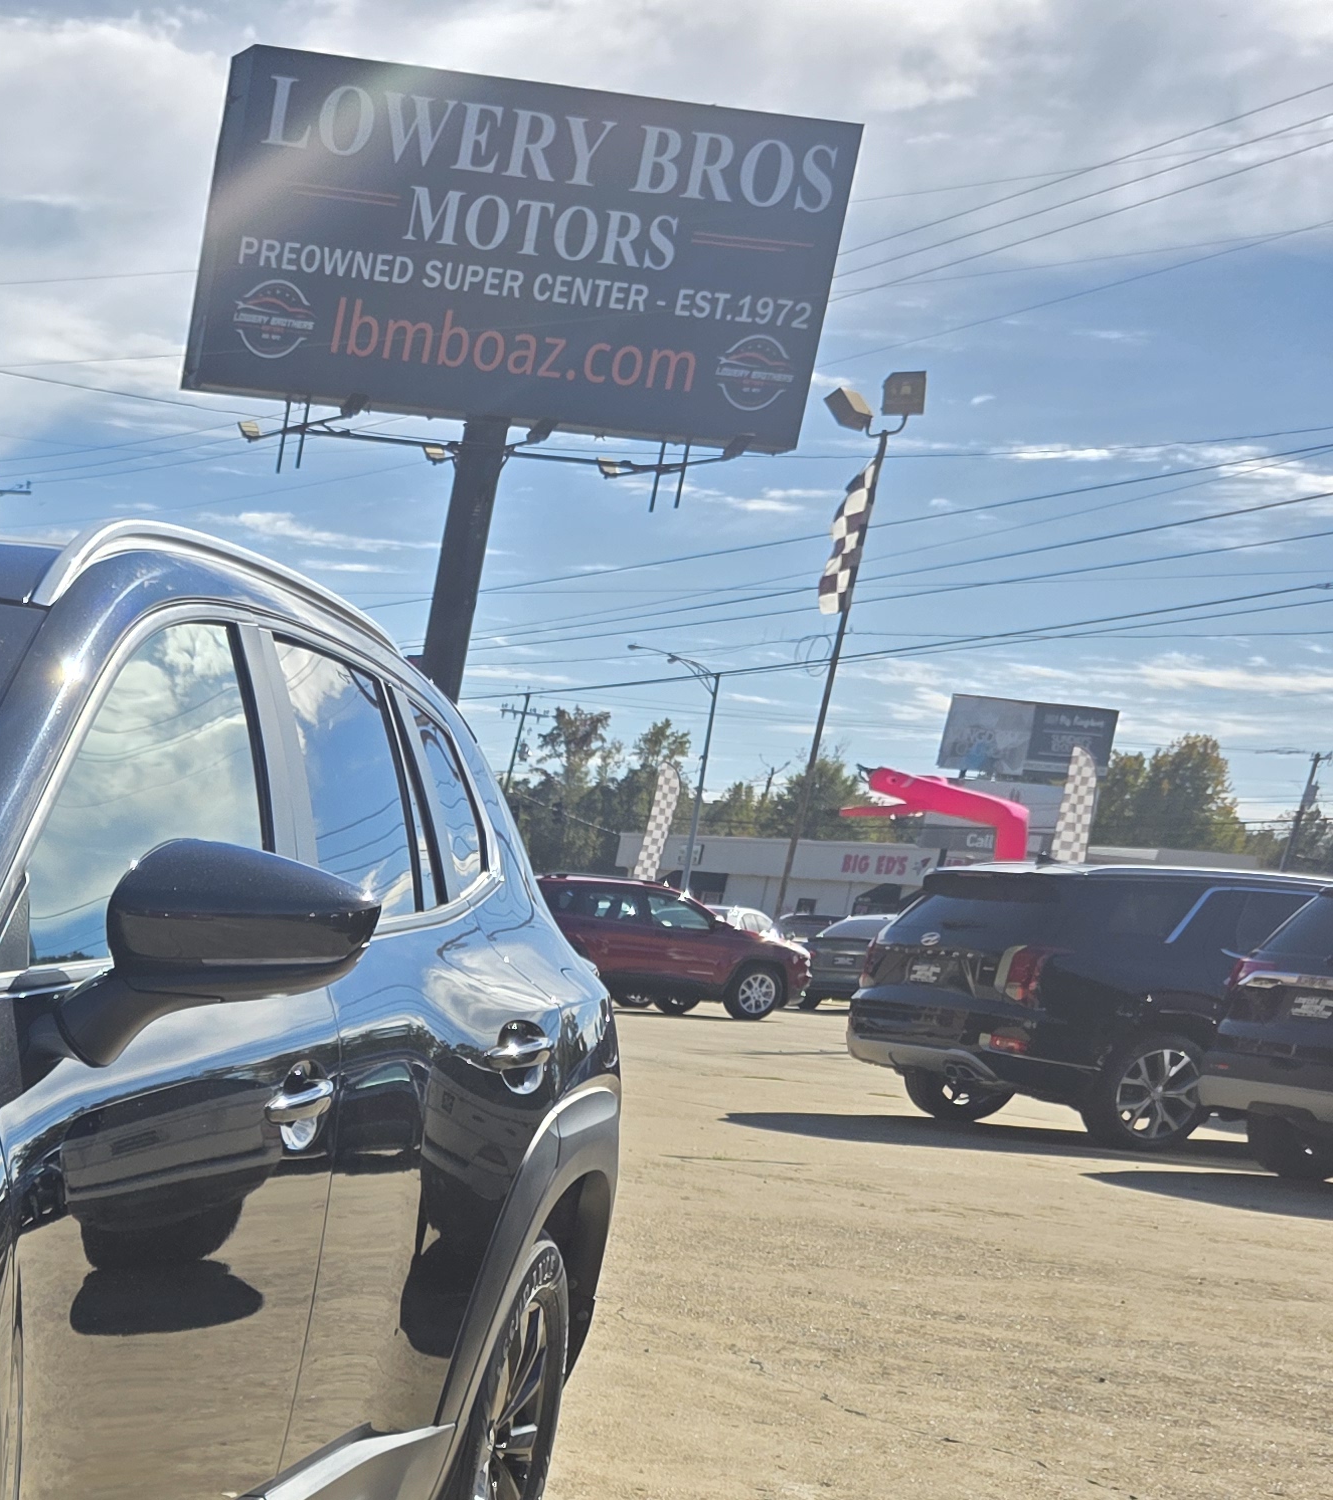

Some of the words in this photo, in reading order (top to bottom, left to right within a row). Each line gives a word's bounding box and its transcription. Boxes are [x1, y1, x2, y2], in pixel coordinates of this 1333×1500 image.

[261, 75, 617, 188] LOWERY
[629, 125, 838, 213] BROS
[402, 186, 679, 271] MOTORS
[238, 236, 413, 284] PREOWNED
[422, 260, 524, 298] SUPER
[533, 273, 649, 312] CENTER
[329, 297, 697, 392] lbmboaz.com
[841, 854, 871, 874] BIG
[875, 854, 909, 876] ED'S
